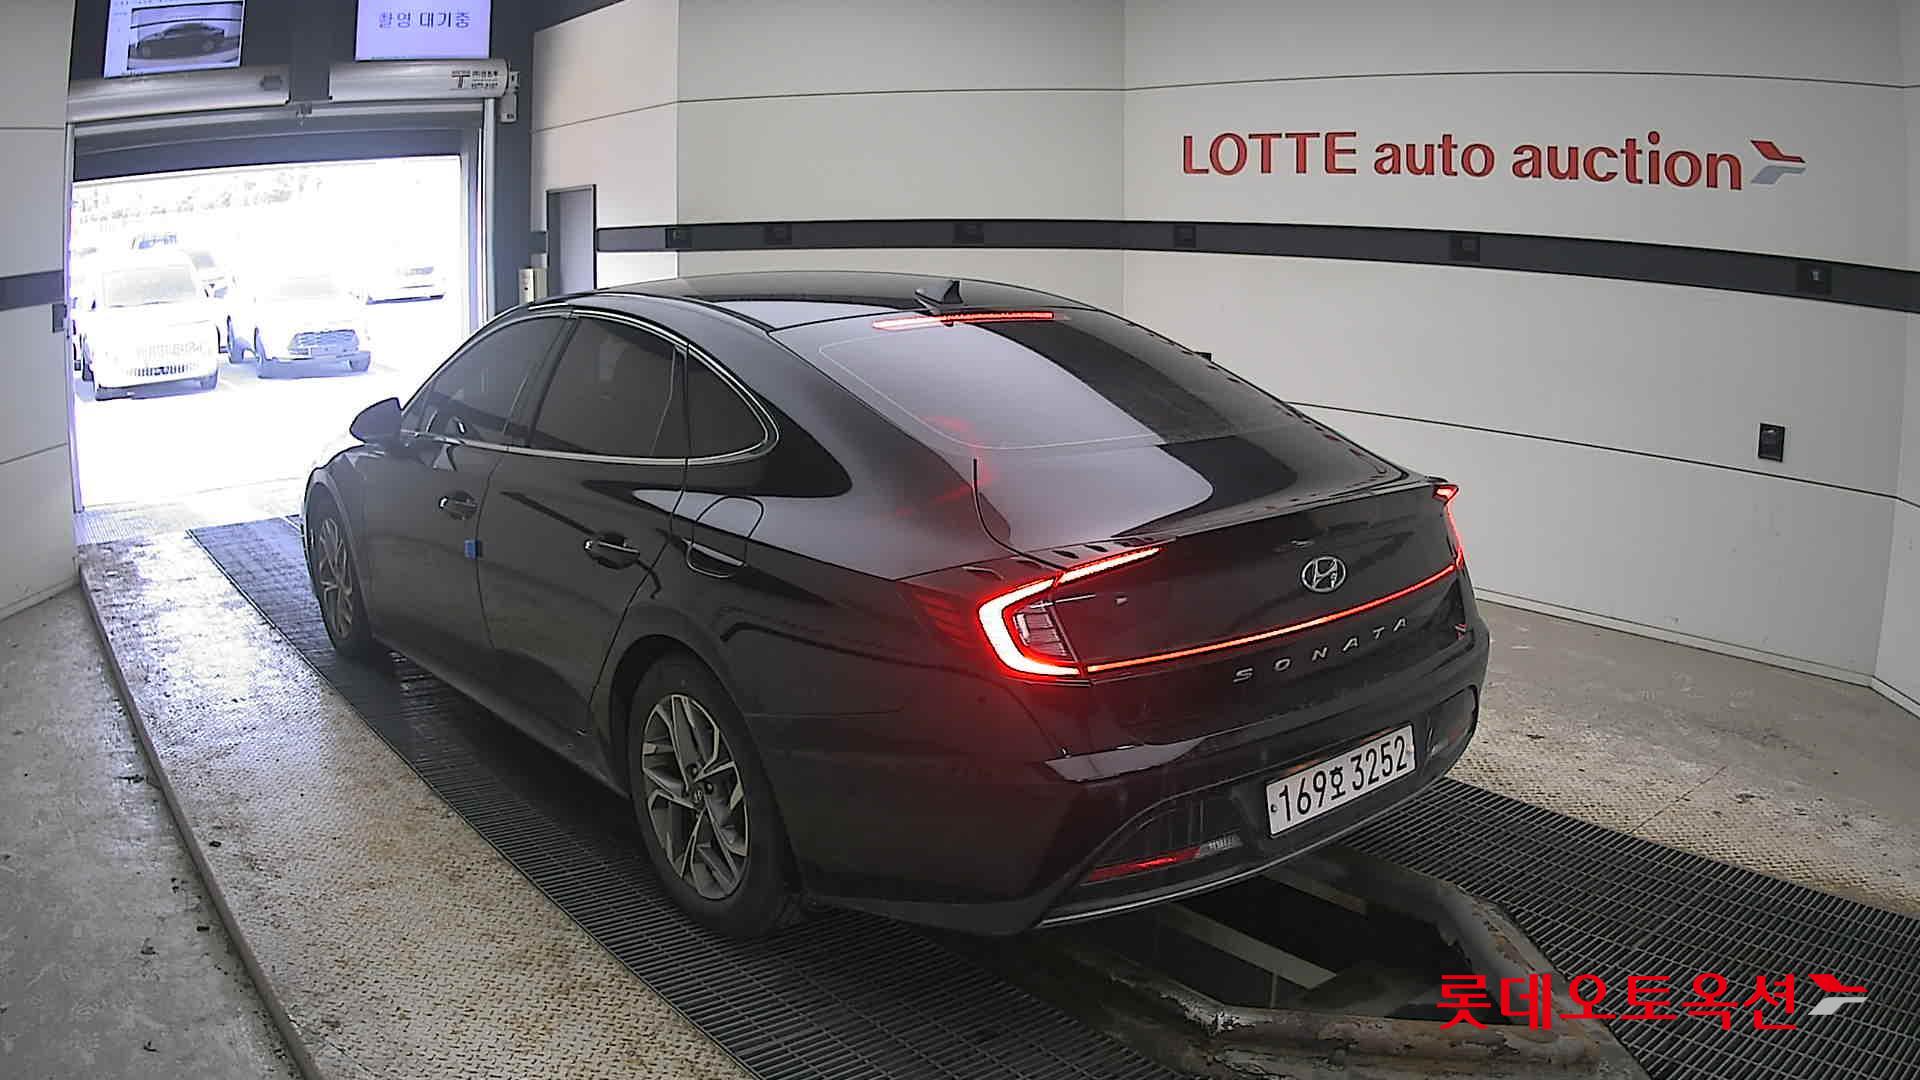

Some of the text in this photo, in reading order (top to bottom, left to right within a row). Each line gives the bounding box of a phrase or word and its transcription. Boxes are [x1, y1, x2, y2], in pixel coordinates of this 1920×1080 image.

[420, 11, 472, 29] 대기중
[1183, 132, 1743, 190] LOTTE auto auction
[1234, 617, 1408, 682] SONATA
[1351, 735, 1408, 791] 3252
